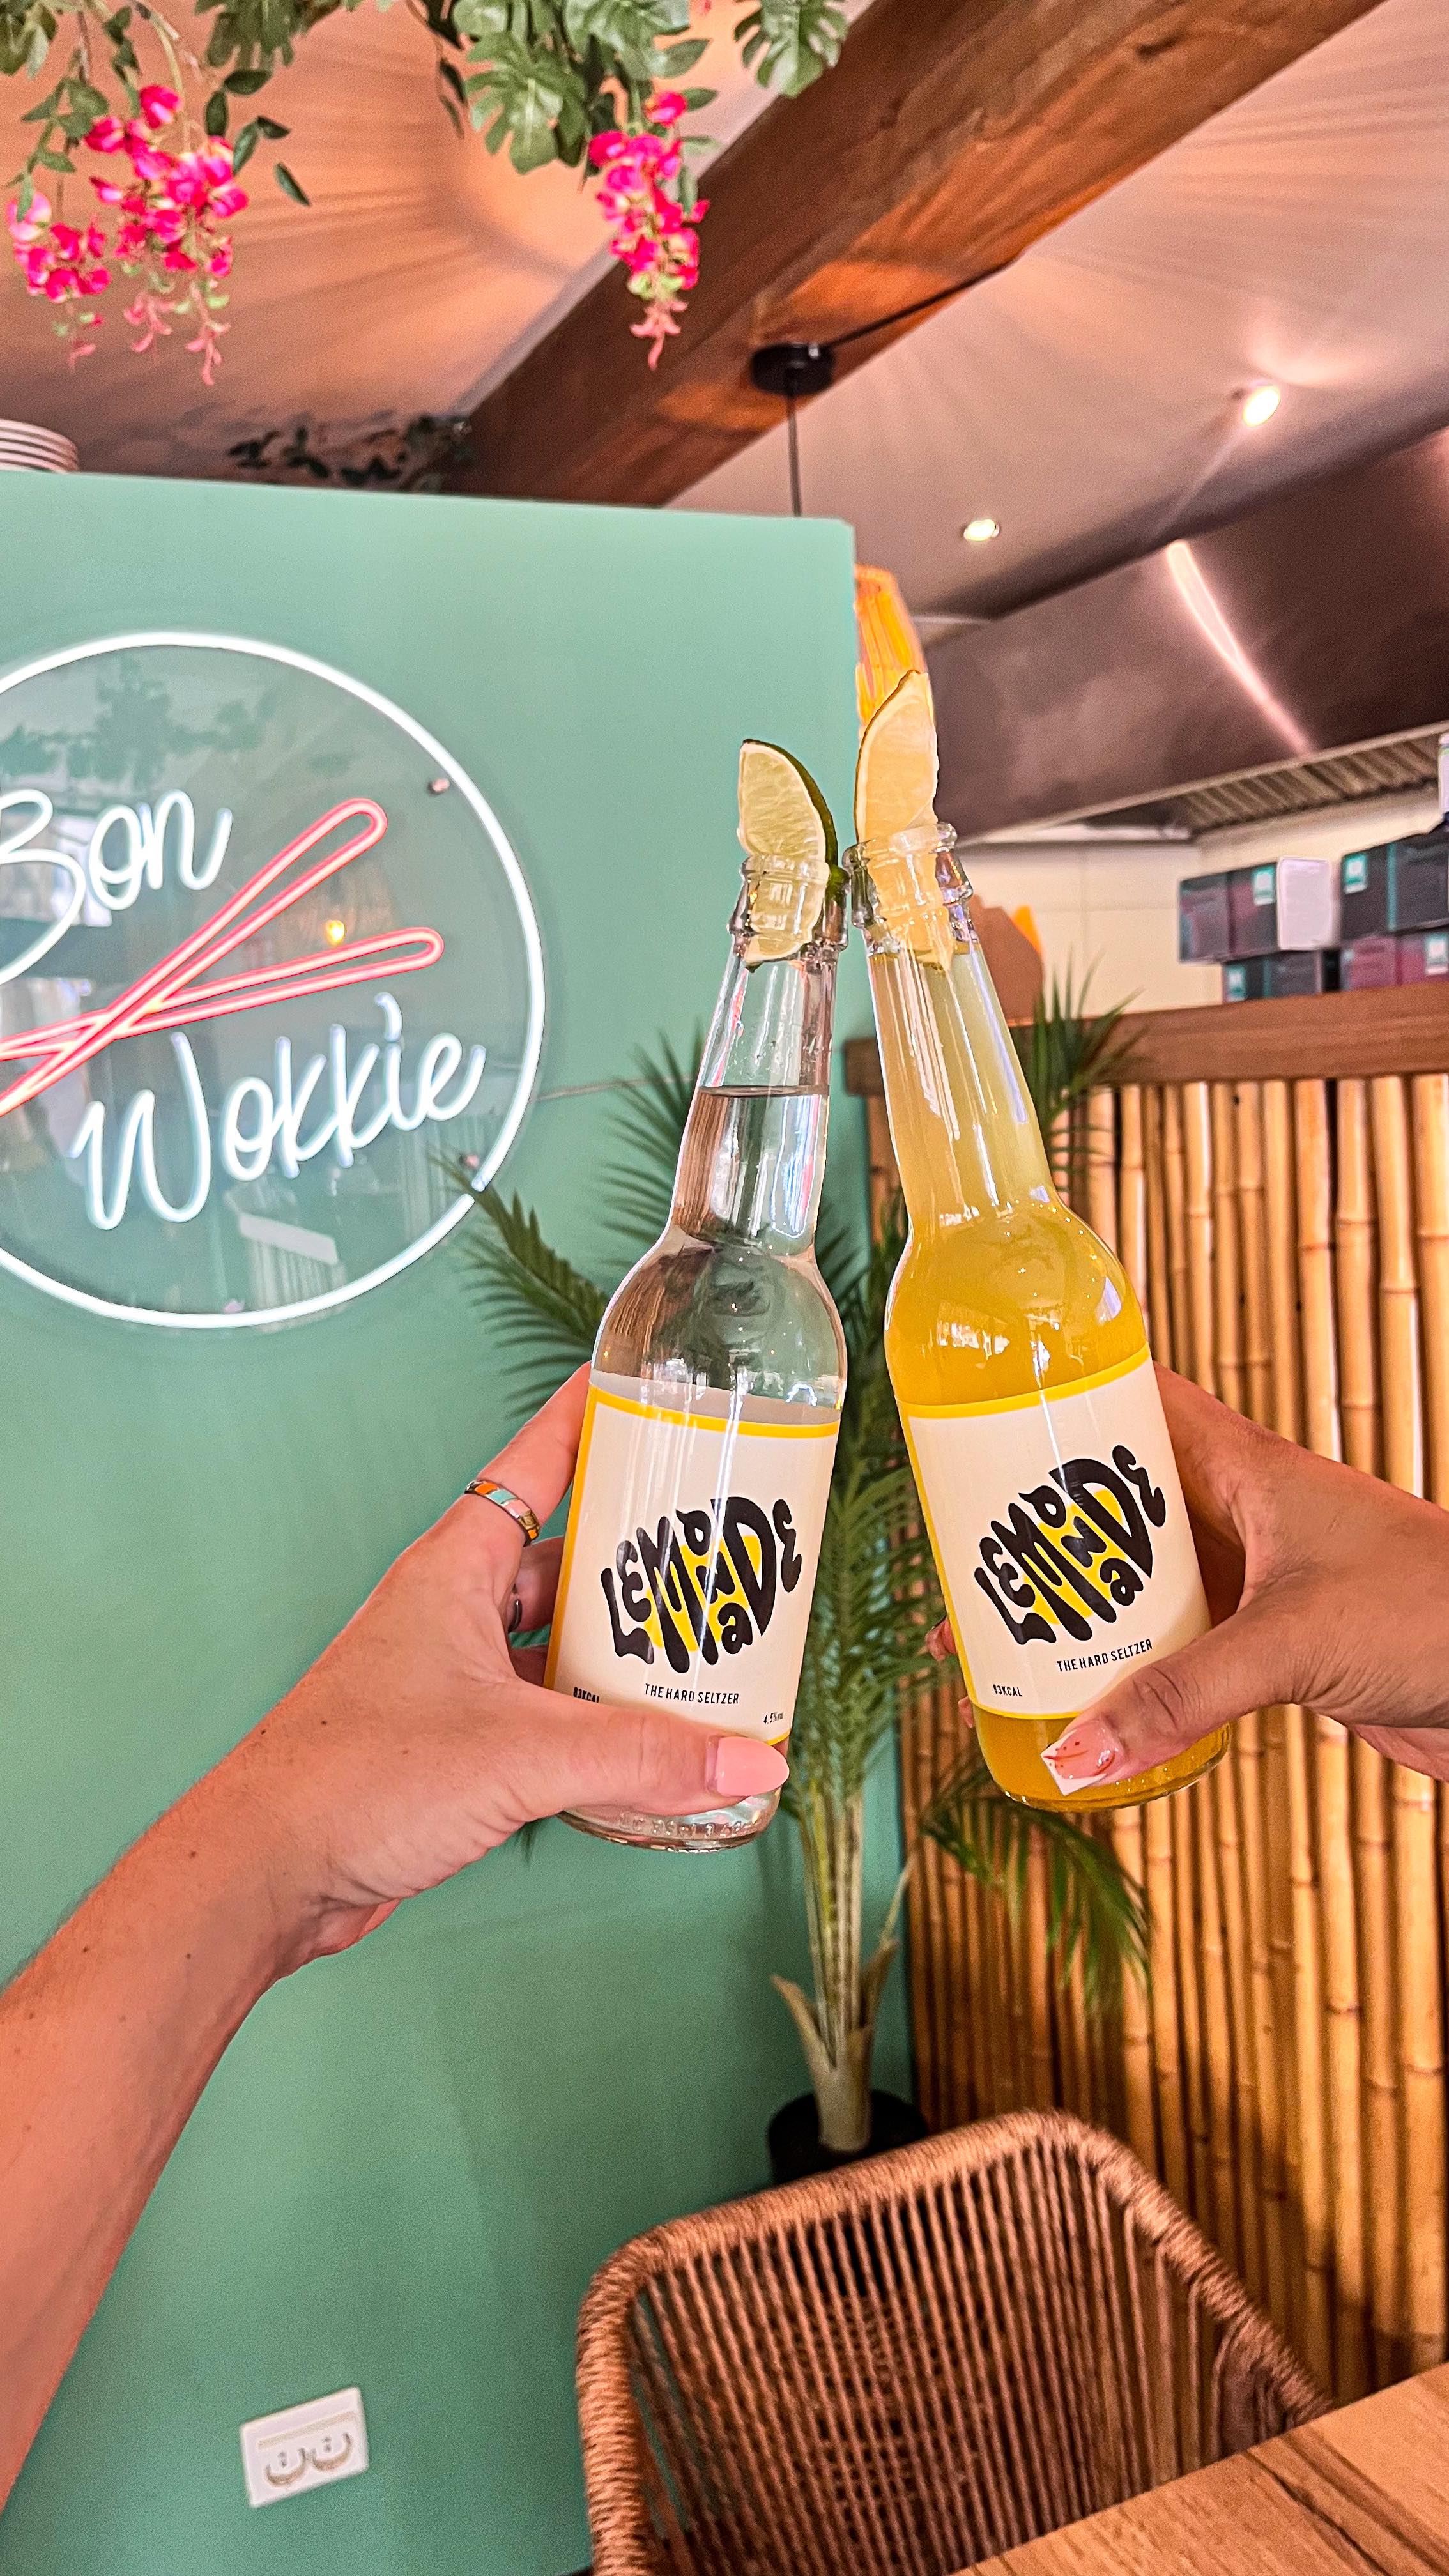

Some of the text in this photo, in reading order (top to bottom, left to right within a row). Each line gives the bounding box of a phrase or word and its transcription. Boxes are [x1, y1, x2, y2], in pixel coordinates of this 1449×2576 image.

[68, 992, 487, 1230] Wokkie
[1057, 1639, 1153, 1672] THE HARD SELTZER
[645, 1683, 739, 1704] THE HARD SELTZER
